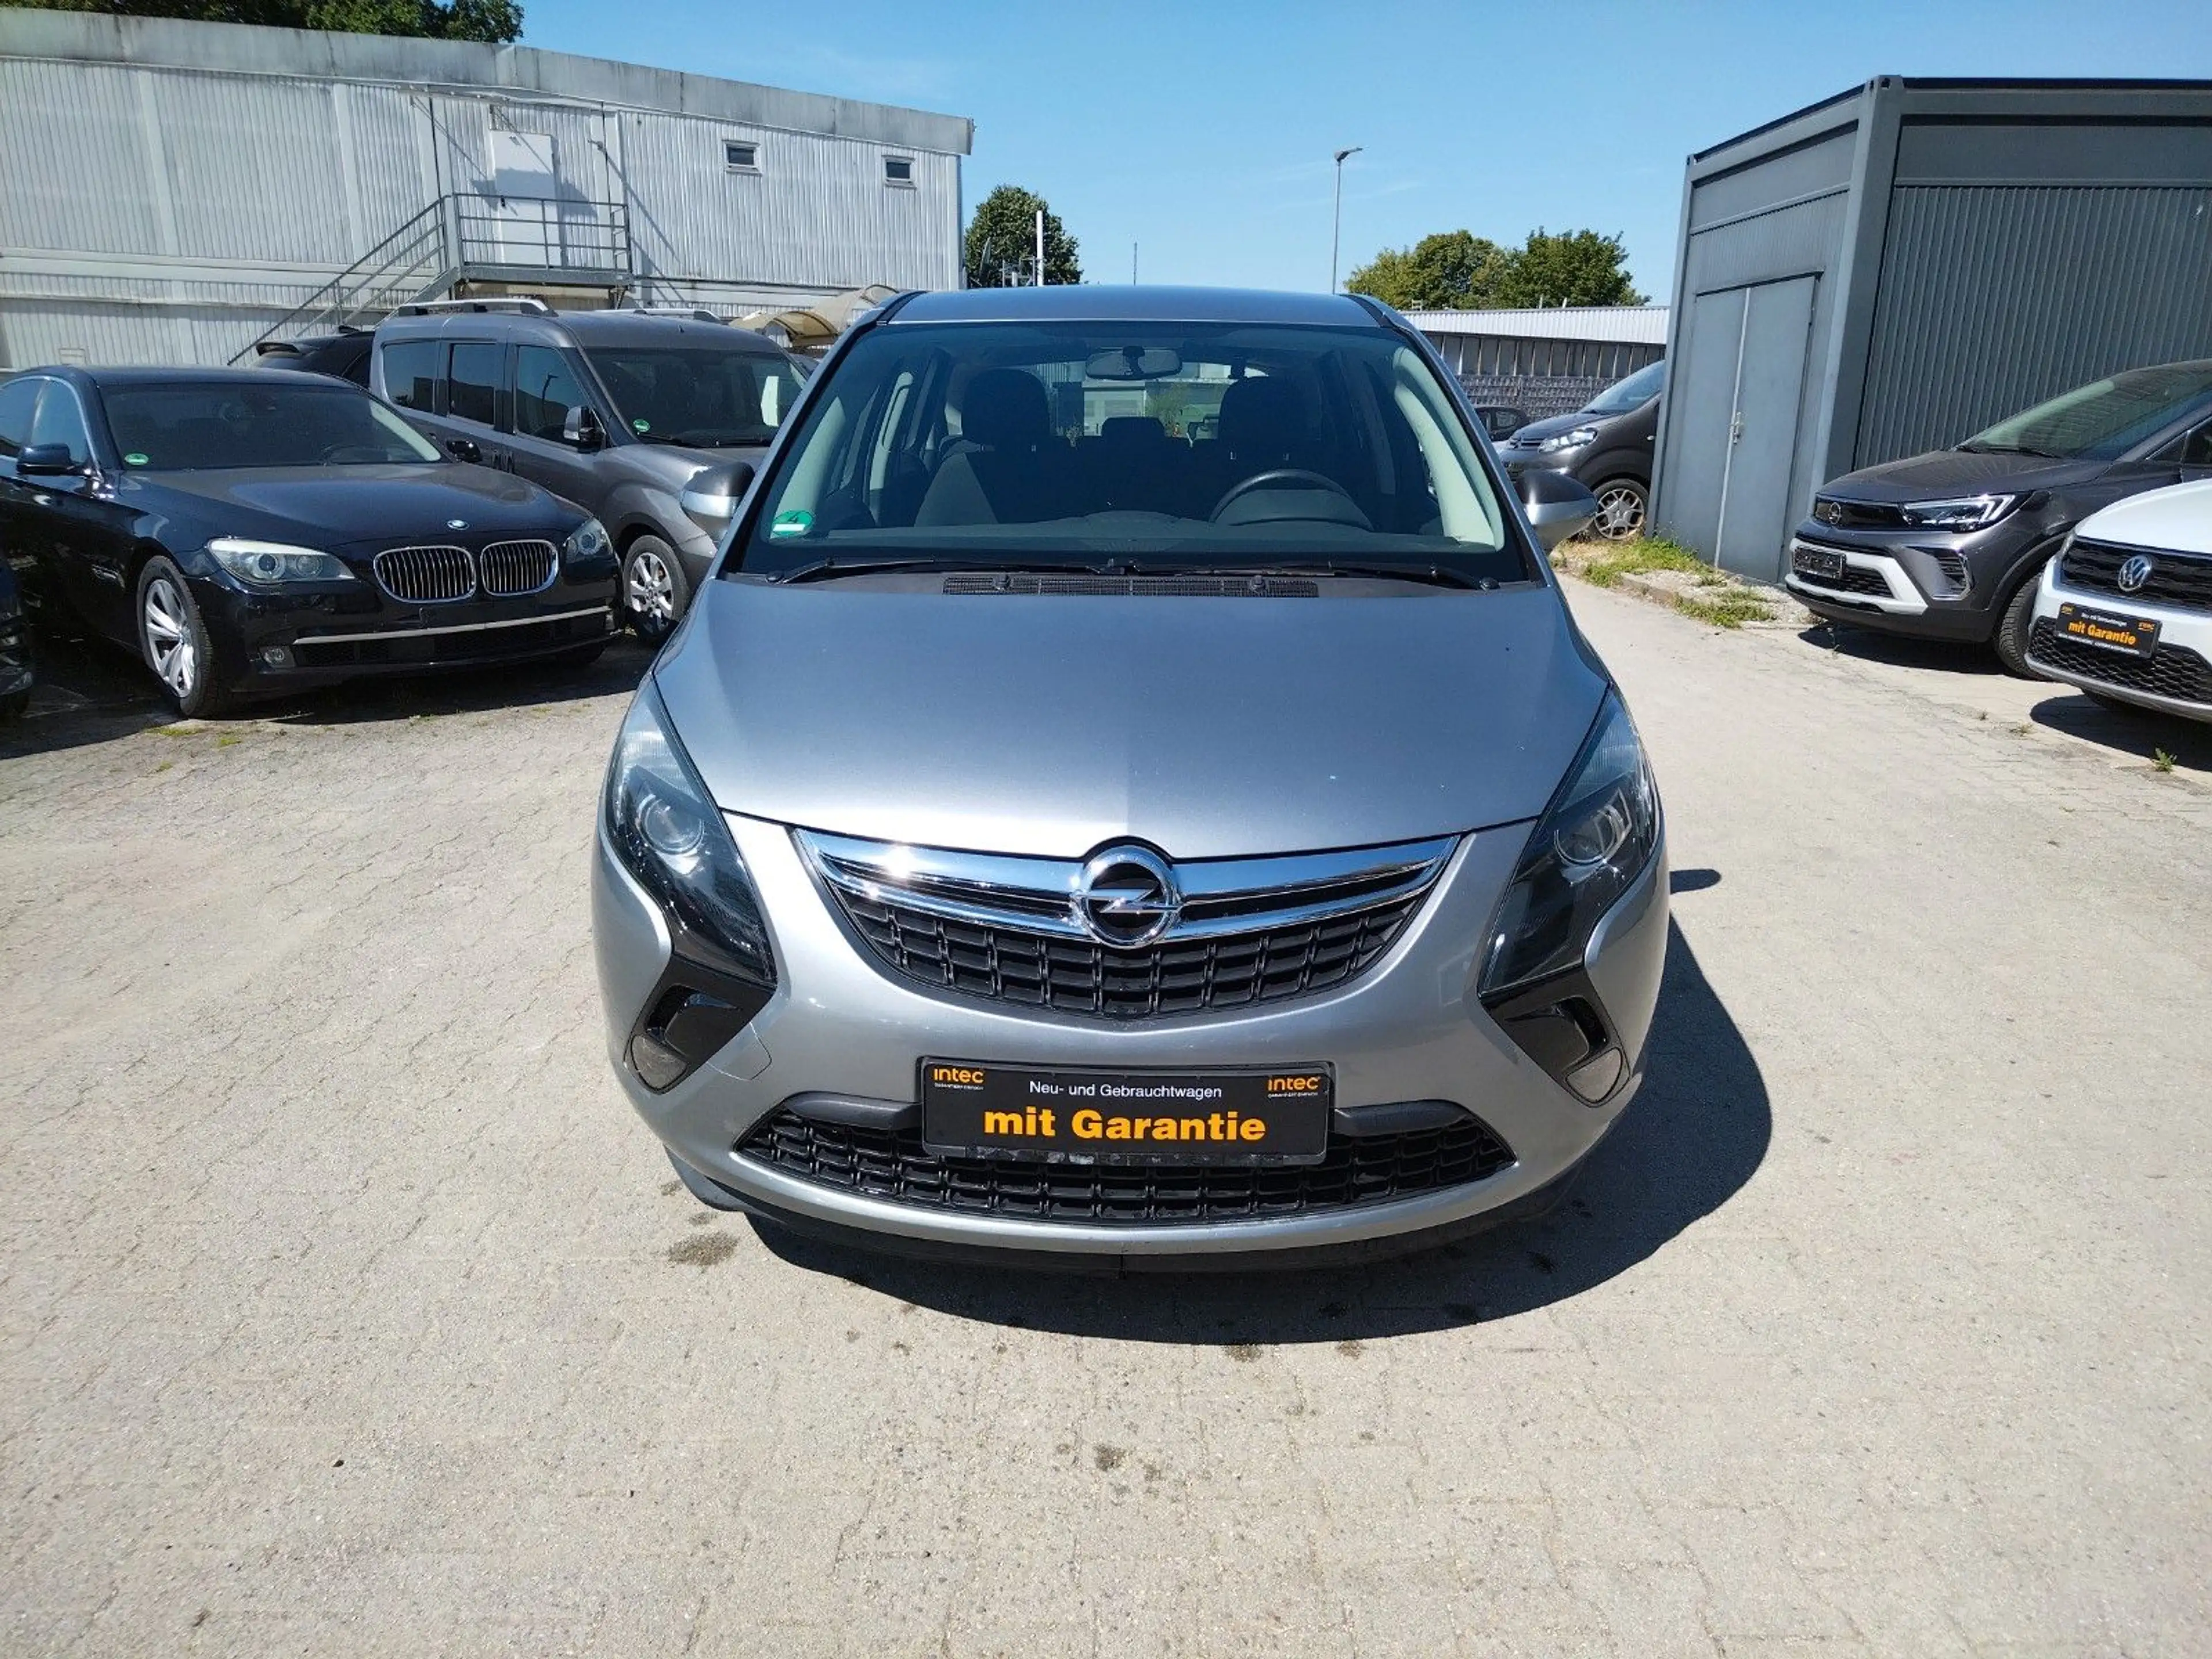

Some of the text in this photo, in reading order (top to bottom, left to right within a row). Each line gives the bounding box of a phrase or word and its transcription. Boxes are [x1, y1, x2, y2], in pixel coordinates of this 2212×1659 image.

[2068, 620, 2085, 634] mit
[2087, 624, 2137, 645] Garantie
[934, 1068, 983, 1083] intec
[1268, 1077, 1319, 1090] intec
[1029, 1081, 1222, 1101] Neu- und Gebrauchtwagen
[984, 1106, 1266, 1141] mit Garantie
